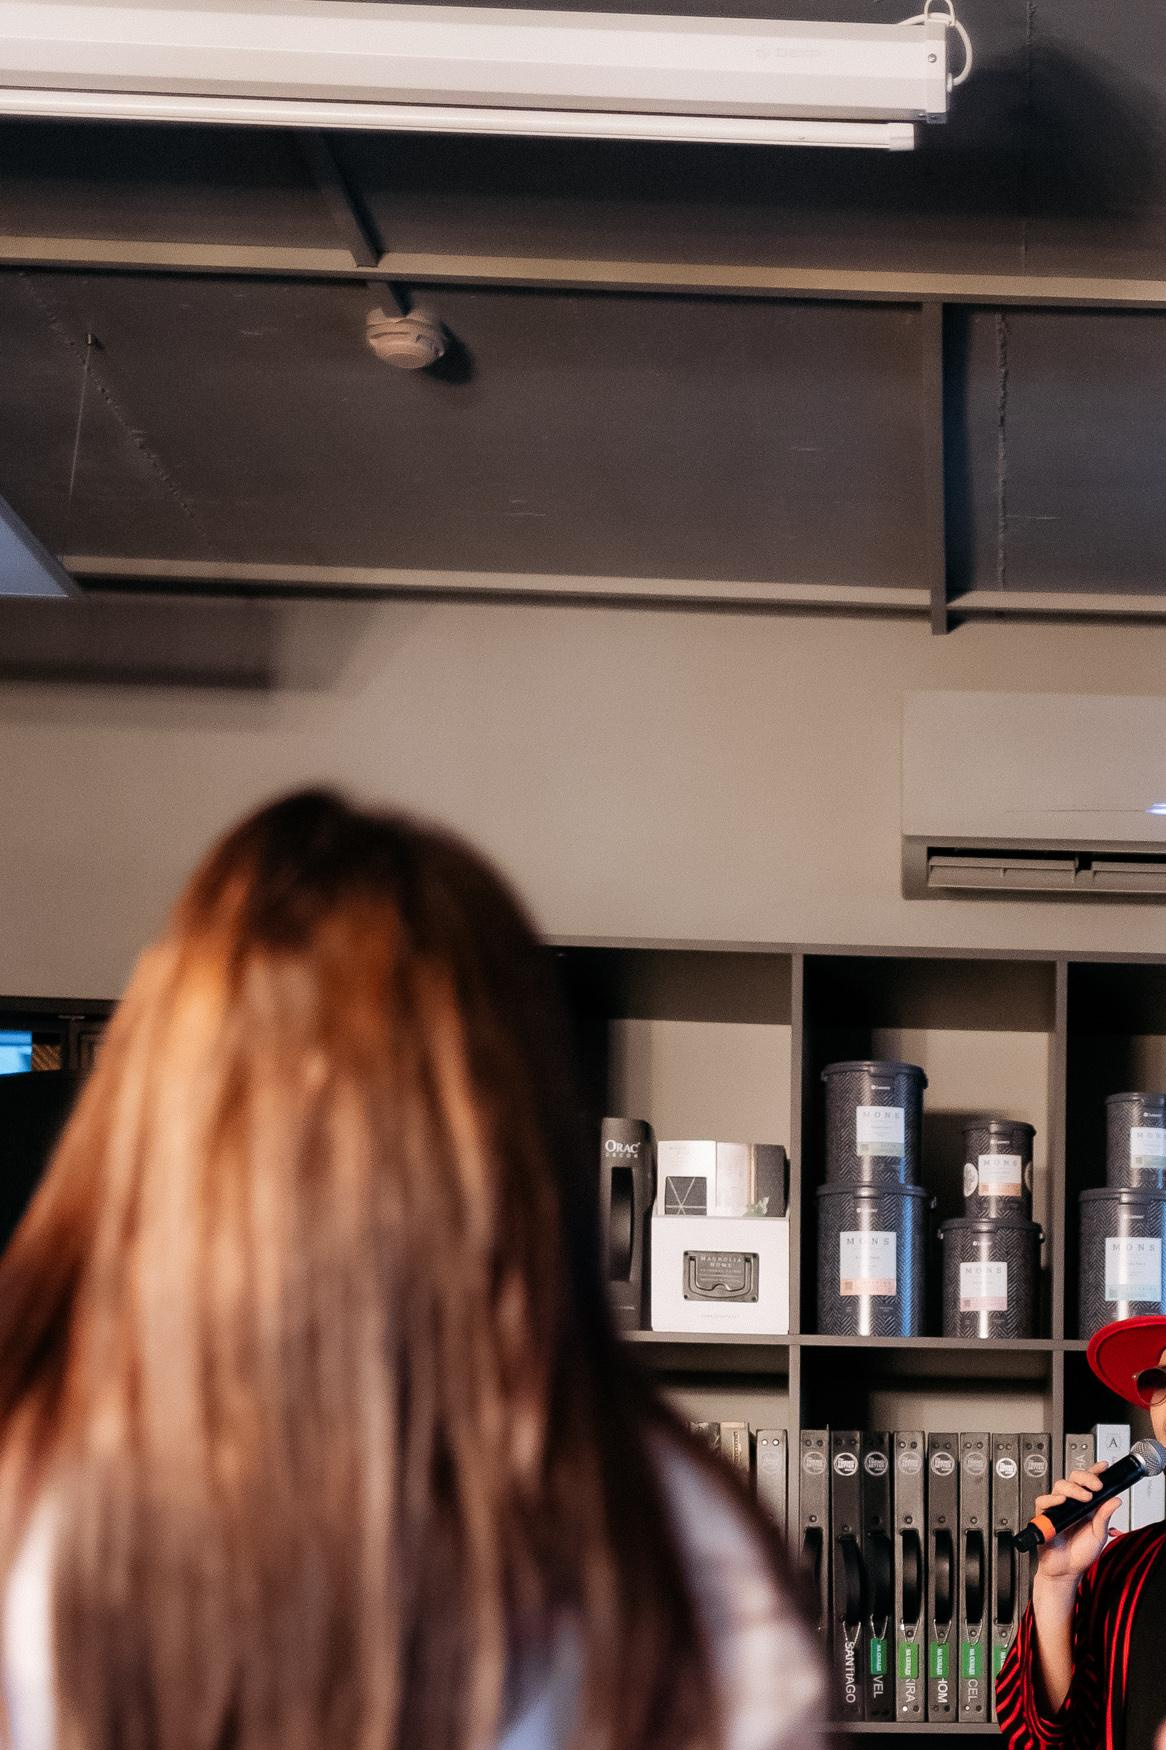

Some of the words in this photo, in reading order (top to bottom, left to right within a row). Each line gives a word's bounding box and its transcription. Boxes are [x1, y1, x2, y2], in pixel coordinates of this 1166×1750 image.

[605, 1139, 638, 1153] ORAC
[1112, 1243, 1156, 1252] MONS
[844, 1641, 857, 1703] SANTIAGO
